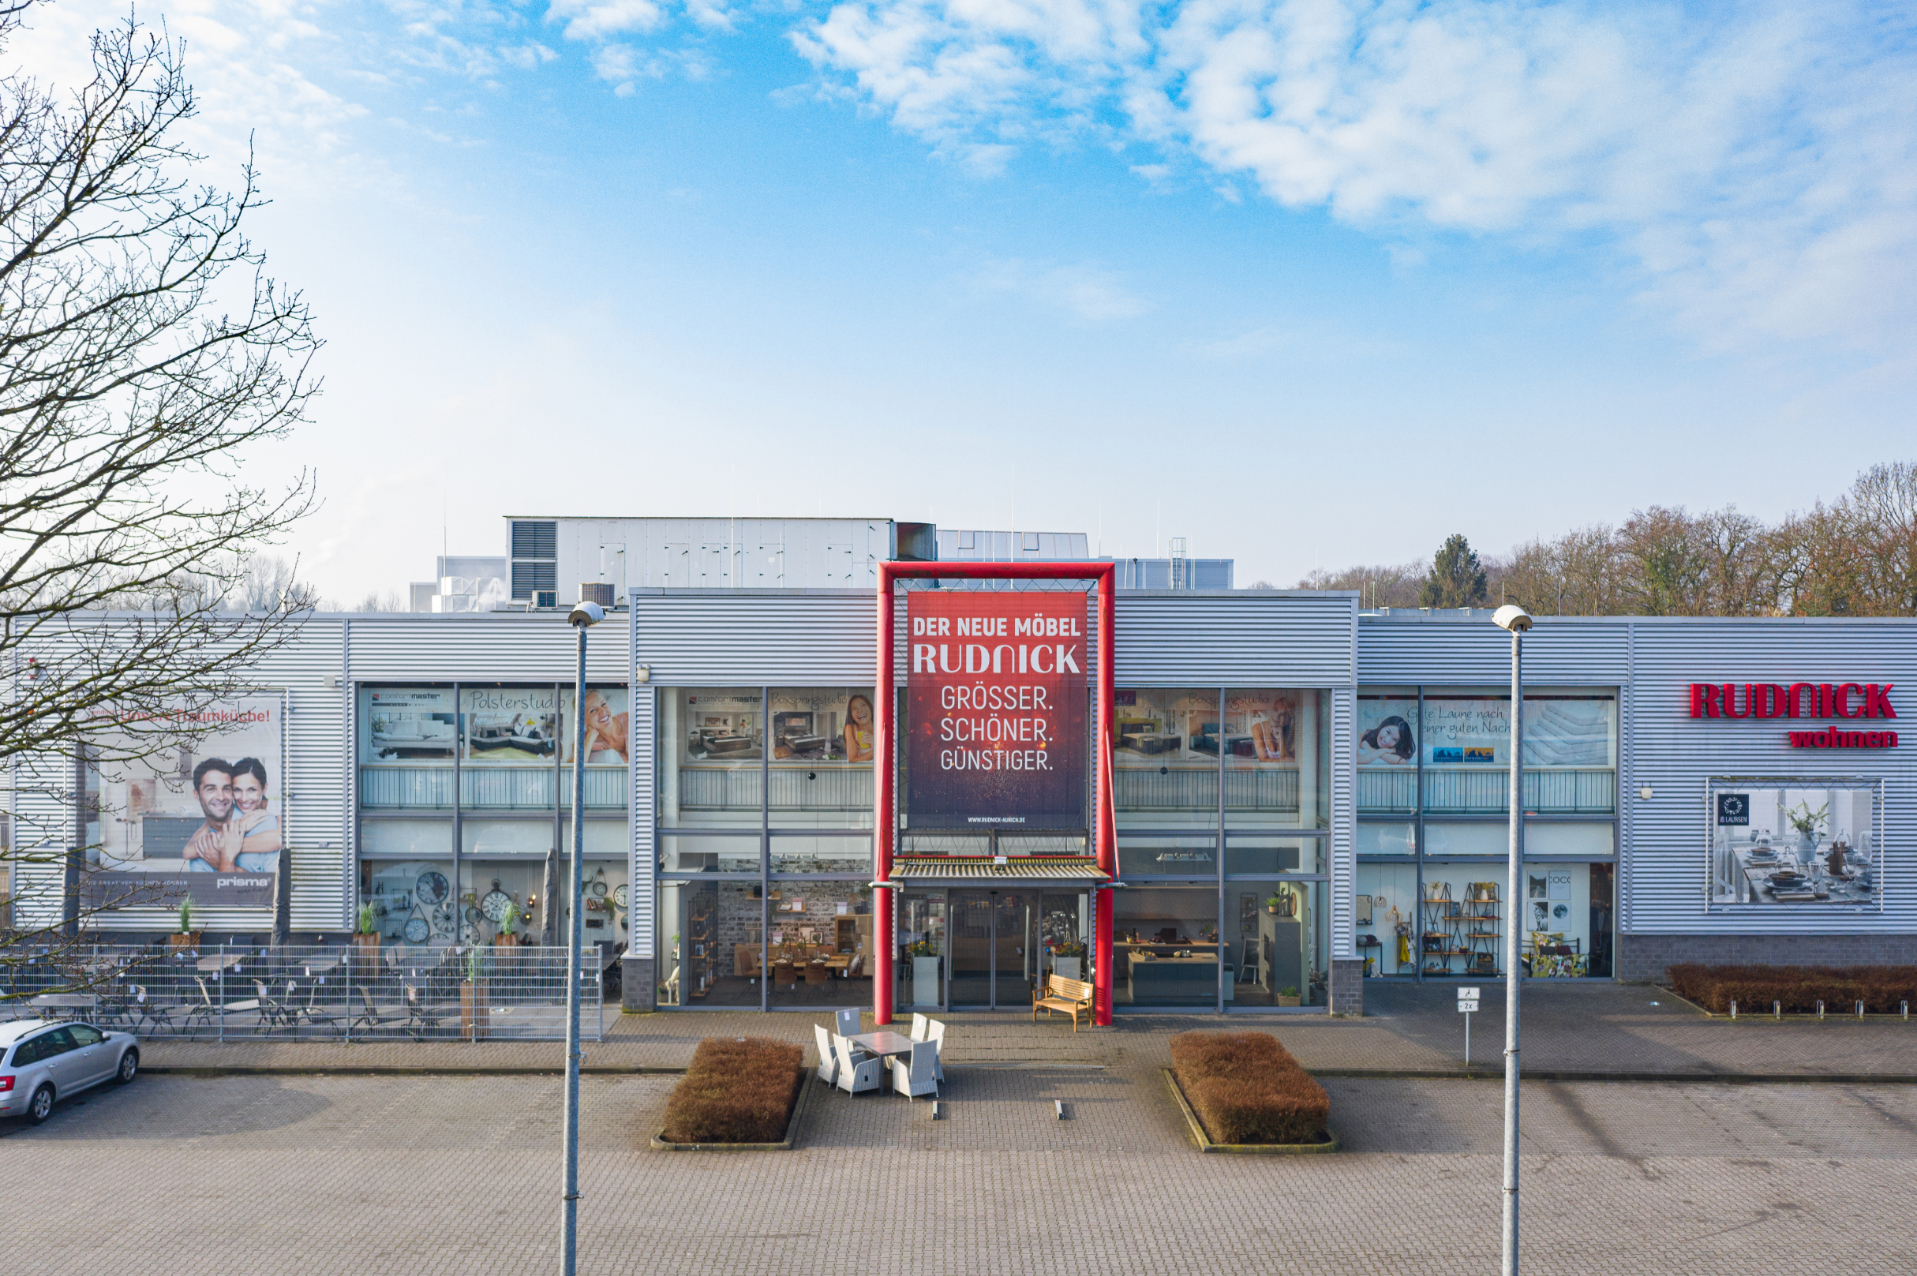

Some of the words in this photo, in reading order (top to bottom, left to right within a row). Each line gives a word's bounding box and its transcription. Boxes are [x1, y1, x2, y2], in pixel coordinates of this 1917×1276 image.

[914, 618, 950, 636] DER
[957, 618, 1007, 636] NEUE
[1014, 613, 1081, 636] MÖBEL
[913, 644, 1081, 674] RUDNICK
[470, 691, 565, 710] Polsterstudo
[941, 681, 1053, 710] GRÖSSER.
[1188, 692, 1270, 710] Boxspingstudio
[1690, 682, 1898, 718] RUDNICK
[1407, 706, 1434, 724] Gte
[1439, 706, 1472, 720] Laune
[1476, 706, 1505, 720] nach
[941, 713, 1053, 741] SCHÖNER.
[1447, 722, 1479, 740] guten
[1482, 720, 1511, 733] Nach
[1788, 726, 1898, 748] wohnen
[941, 746, 1053, 770] GÜNSTIGER.
